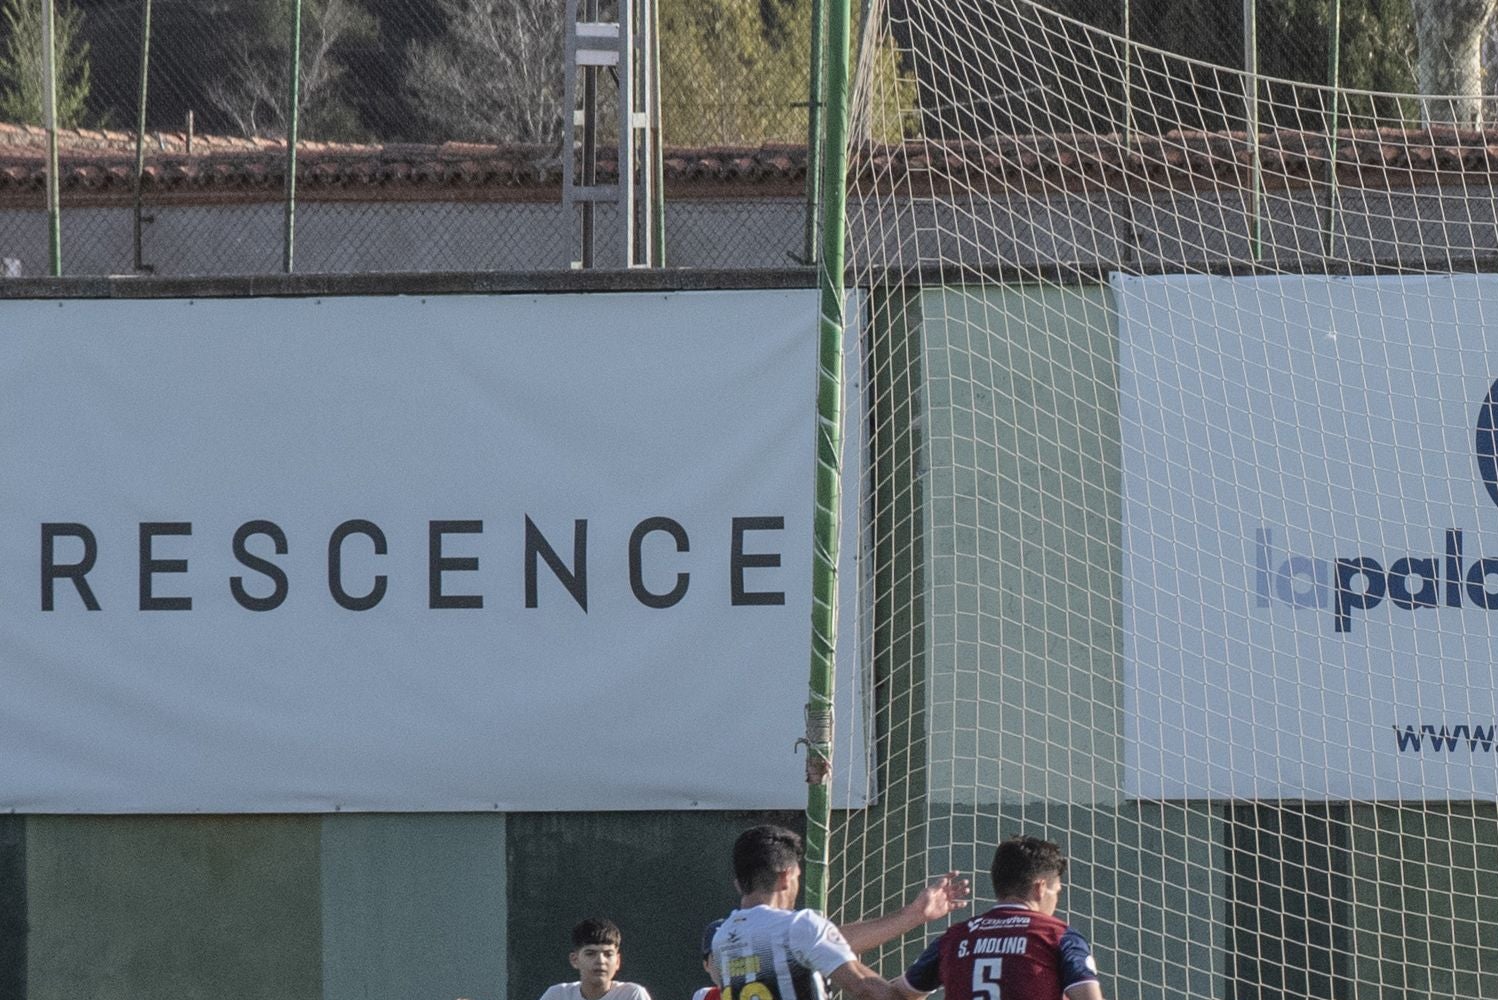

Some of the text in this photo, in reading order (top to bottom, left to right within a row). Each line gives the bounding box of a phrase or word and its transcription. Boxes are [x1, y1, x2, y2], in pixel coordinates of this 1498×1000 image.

[40, 513, 786, 614] RESCENCE
[958, 937, 1027, 958] S. MOLINA
